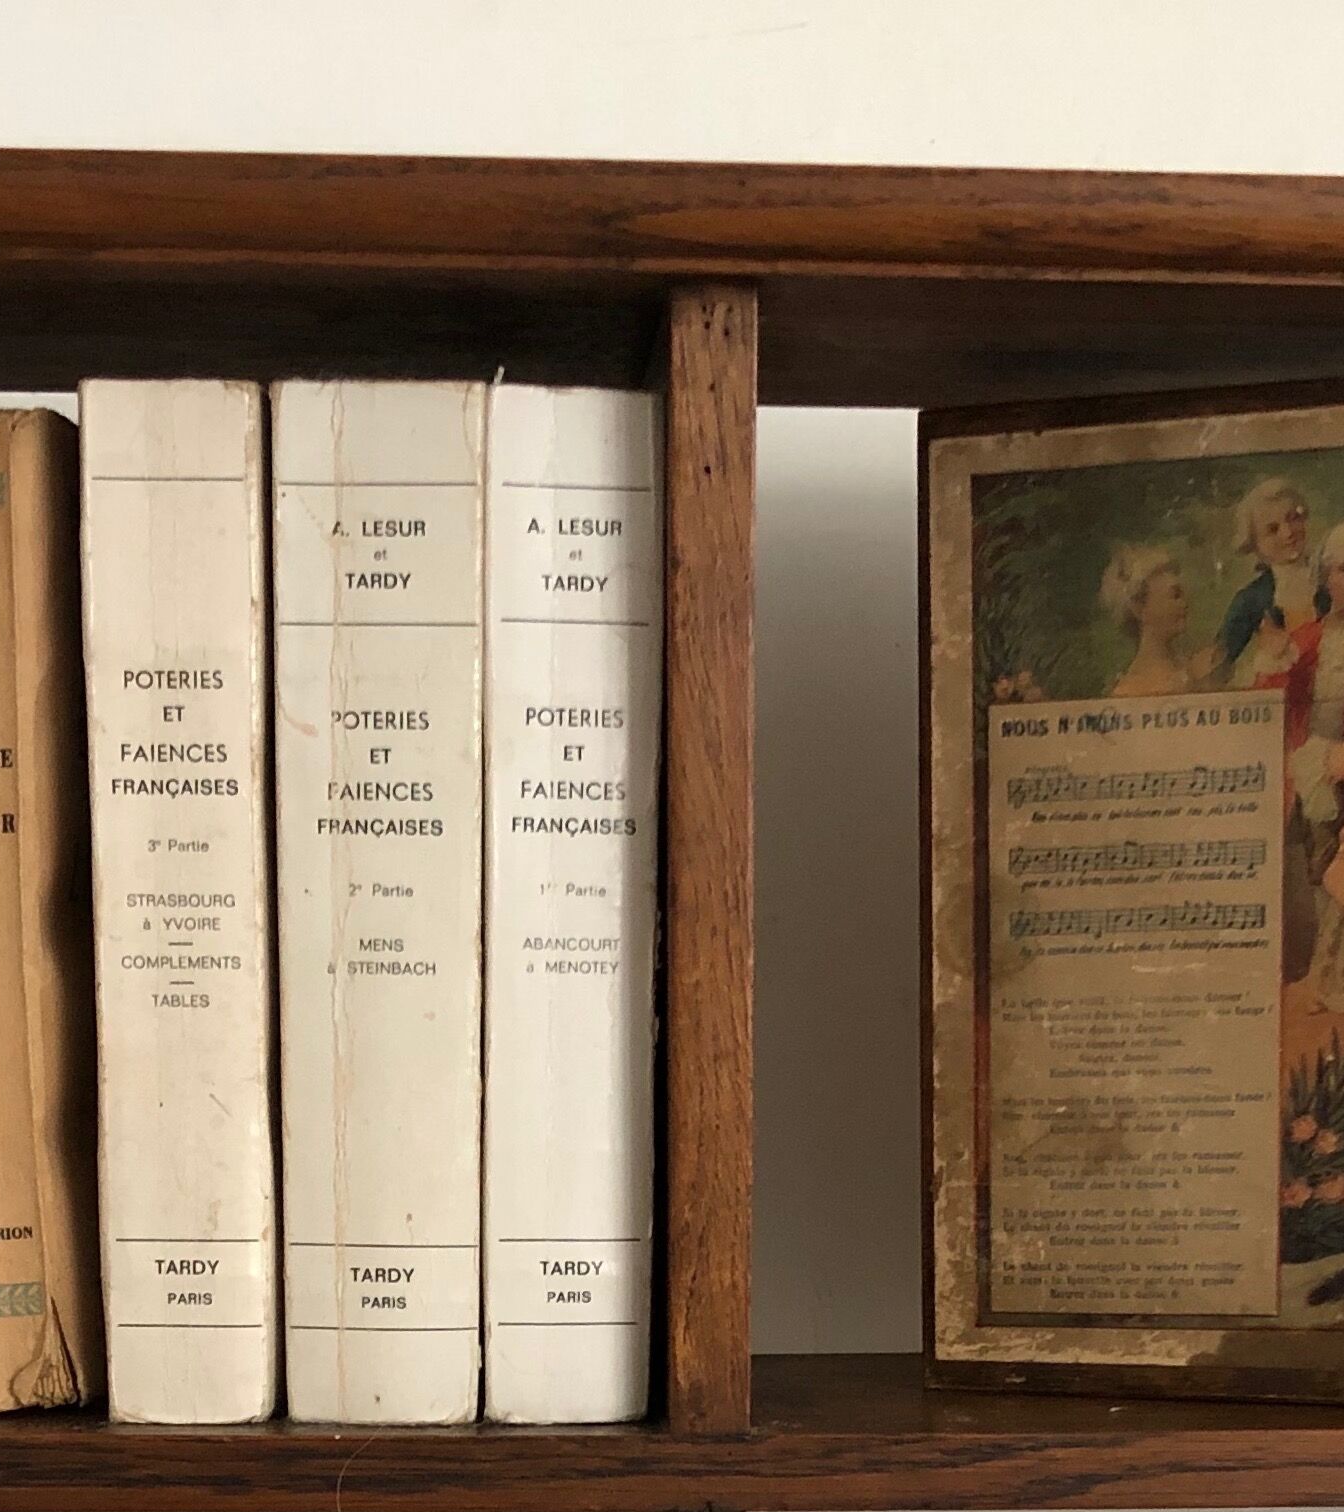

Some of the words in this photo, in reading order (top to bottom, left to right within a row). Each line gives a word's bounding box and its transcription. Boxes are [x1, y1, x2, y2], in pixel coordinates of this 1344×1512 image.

[332, 521, 350, 537] A.
[362, 521, 426, 537] LESUR
[527, 518, 545, 534] A.
[558, 519, 622, 536] LESUR
[374, 549, 388, 561] et
[569, 549, 583, 561] et
[345, 573, 412, 590] TARDY
[542, 575, 608, 592] TARDY
[123, 670, 224, 690] POTERIES
[163, 706, 185, 722] ET
[331, 711, 430, 731] POTERIES
[525, 707, 624, 728] POTERIES
[1001, 719, 1048, 738] NOUS
[1141, 708, 1189, 729] PLUS
[1196, 707, 1221, 727] AU
[1229, 705, 1272, 725] BOIS
[121, 744, 228, 763] FAIENCES
[370, 749, 392, 764] ET
[563, 746, 585, 762] ET
[111, 779, 239, 799] FRANÇAISES
[328, 782, 434, 801] FAIENCES
[520, 780, 625, 801] FAIENCES
[317, 818, 444, 838] FRANÇAISES
[511, 817, 637, 839] FRANÇAISES
[168, 839, 210, 853] Partie
[372, 884, 414, 897] Partie
[565, 883, 606, 897] Partie
[126, 894, 236, 908] STRASBOURG
[143, 918, 152, 931] à
[163, 917, 222, 931] YVOIRE
[359, 939, 405, 953] MENS
[522, 938, 620, 951] ABANCOURT
[121, 956, 242, 970] COMPLEMENTS
[347, 961, 437, 976] STEINBACH
[545, 960, 619, 975] MENOTEY
[152, 994, 210, 1008] TABLES
[155, 1259, 220, 1276] TARDY
[350, 1267, 415, 1284] TARDY
[539, 1260, 604, 1277] TARDY
[167, 1292, 213, 1306] PARIS
[361, 1296, 407, 1309] PARIS
[546, 1290, 592, 1304] PARIS
